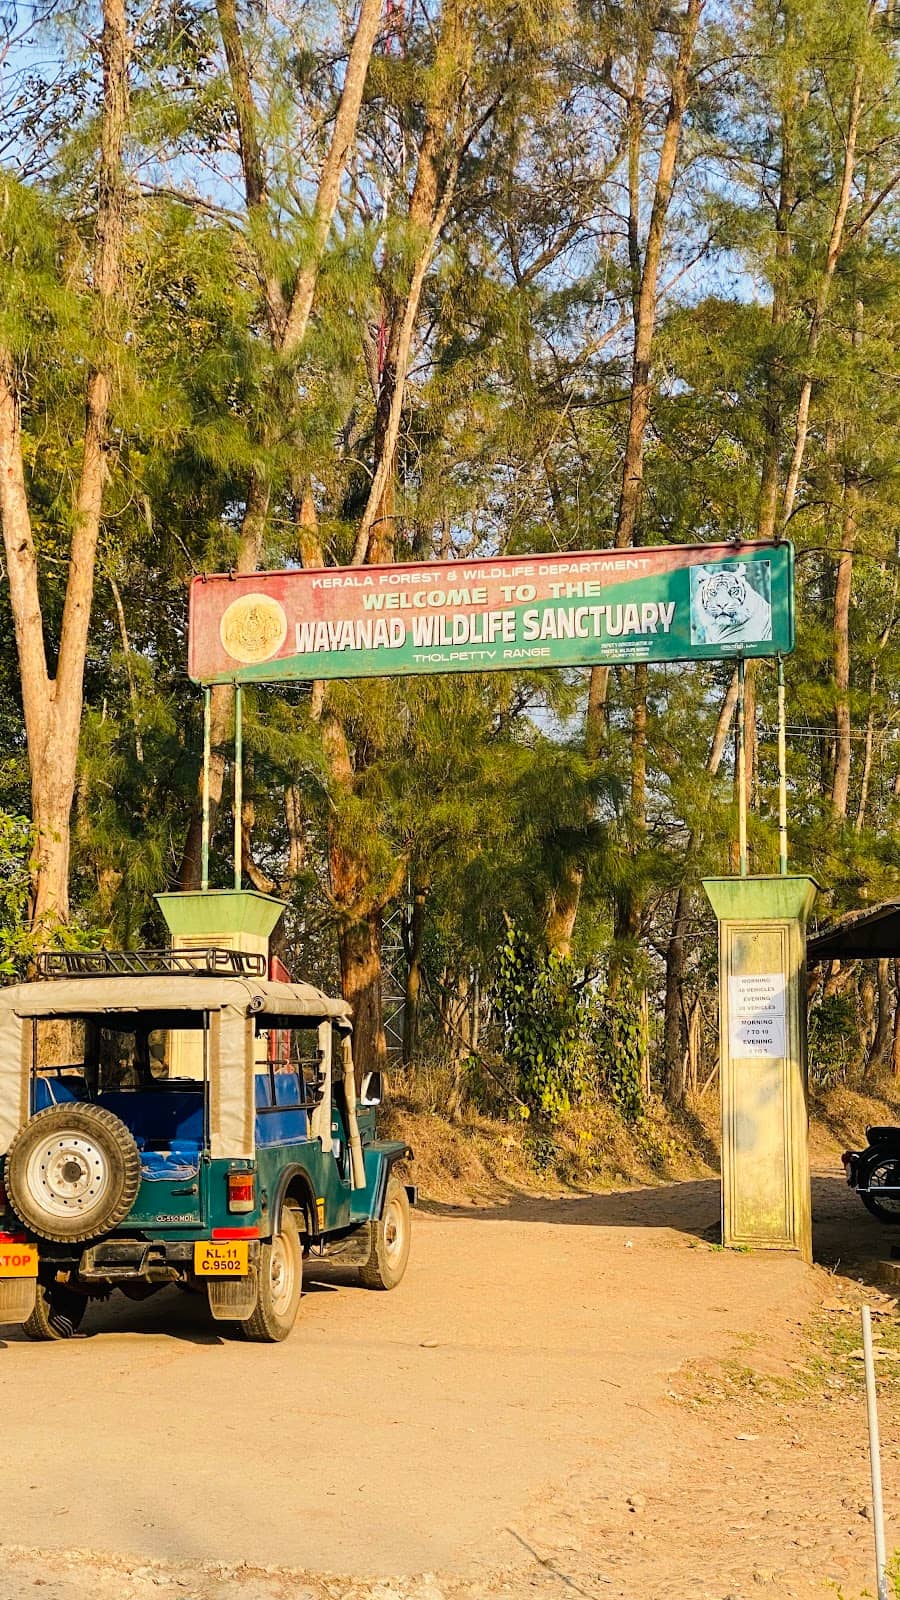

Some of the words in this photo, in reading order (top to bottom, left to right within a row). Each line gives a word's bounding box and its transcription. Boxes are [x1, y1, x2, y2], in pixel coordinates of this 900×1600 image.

[311, 576, 374, 589] KERALA
[379, 571, 442, 585] FOREST
[447, 571, 457, 581] &
[463, 565, 535, 580] WILDLIFE
[539, 558, 650, 576] DEPARTMENT
[362, 587, 488, 611] WELCOME
[500, 584, 536, 602] TO
[550, 580, 601, 599] THE
[295, 617, 406, 653] WAYANAD
[412, 610, 517, 648] WILDLIFE
[523, 602, 676, 641] SANCTUARY
[412, 650, 497, 663] THOLPETTY
[503, 647, 551, 659] RANGE
[0, 1255, 31, 1267] TOP
[202, 1260, 241, 1270] C.9502
